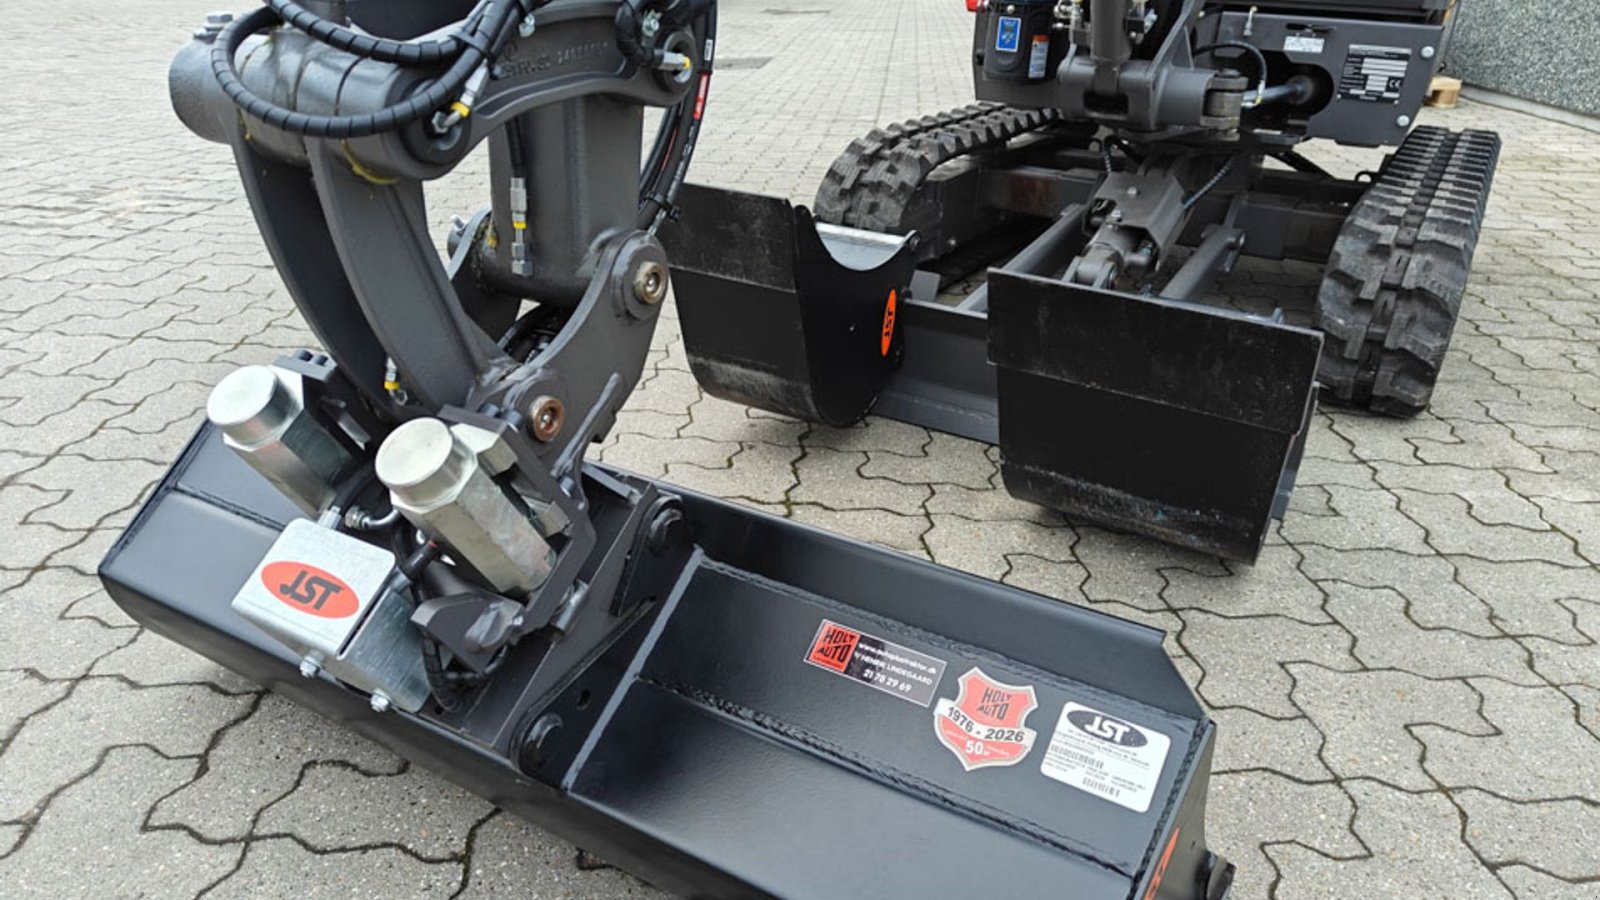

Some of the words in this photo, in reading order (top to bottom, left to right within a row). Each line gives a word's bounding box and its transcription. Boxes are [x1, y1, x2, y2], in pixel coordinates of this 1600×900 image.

[279, 570, 342, 610] JST
[823, 628, 856, 645] HOLT
[817, 643, 852, 663] AUTO
[862, 668, 874, 679] 21
[885, 676, 899, 688] 29
[898, 682, 912, 693] 69
[980, 686, 1013, 704] HOLT
[976, 703, 1010, 721] AUTO
[947, 706, 975, 733] 1976
[984, 728, 1025, 743] 2026
[1084, 716, 1130, 743] JST
[965, 740, 983, 755] 50
